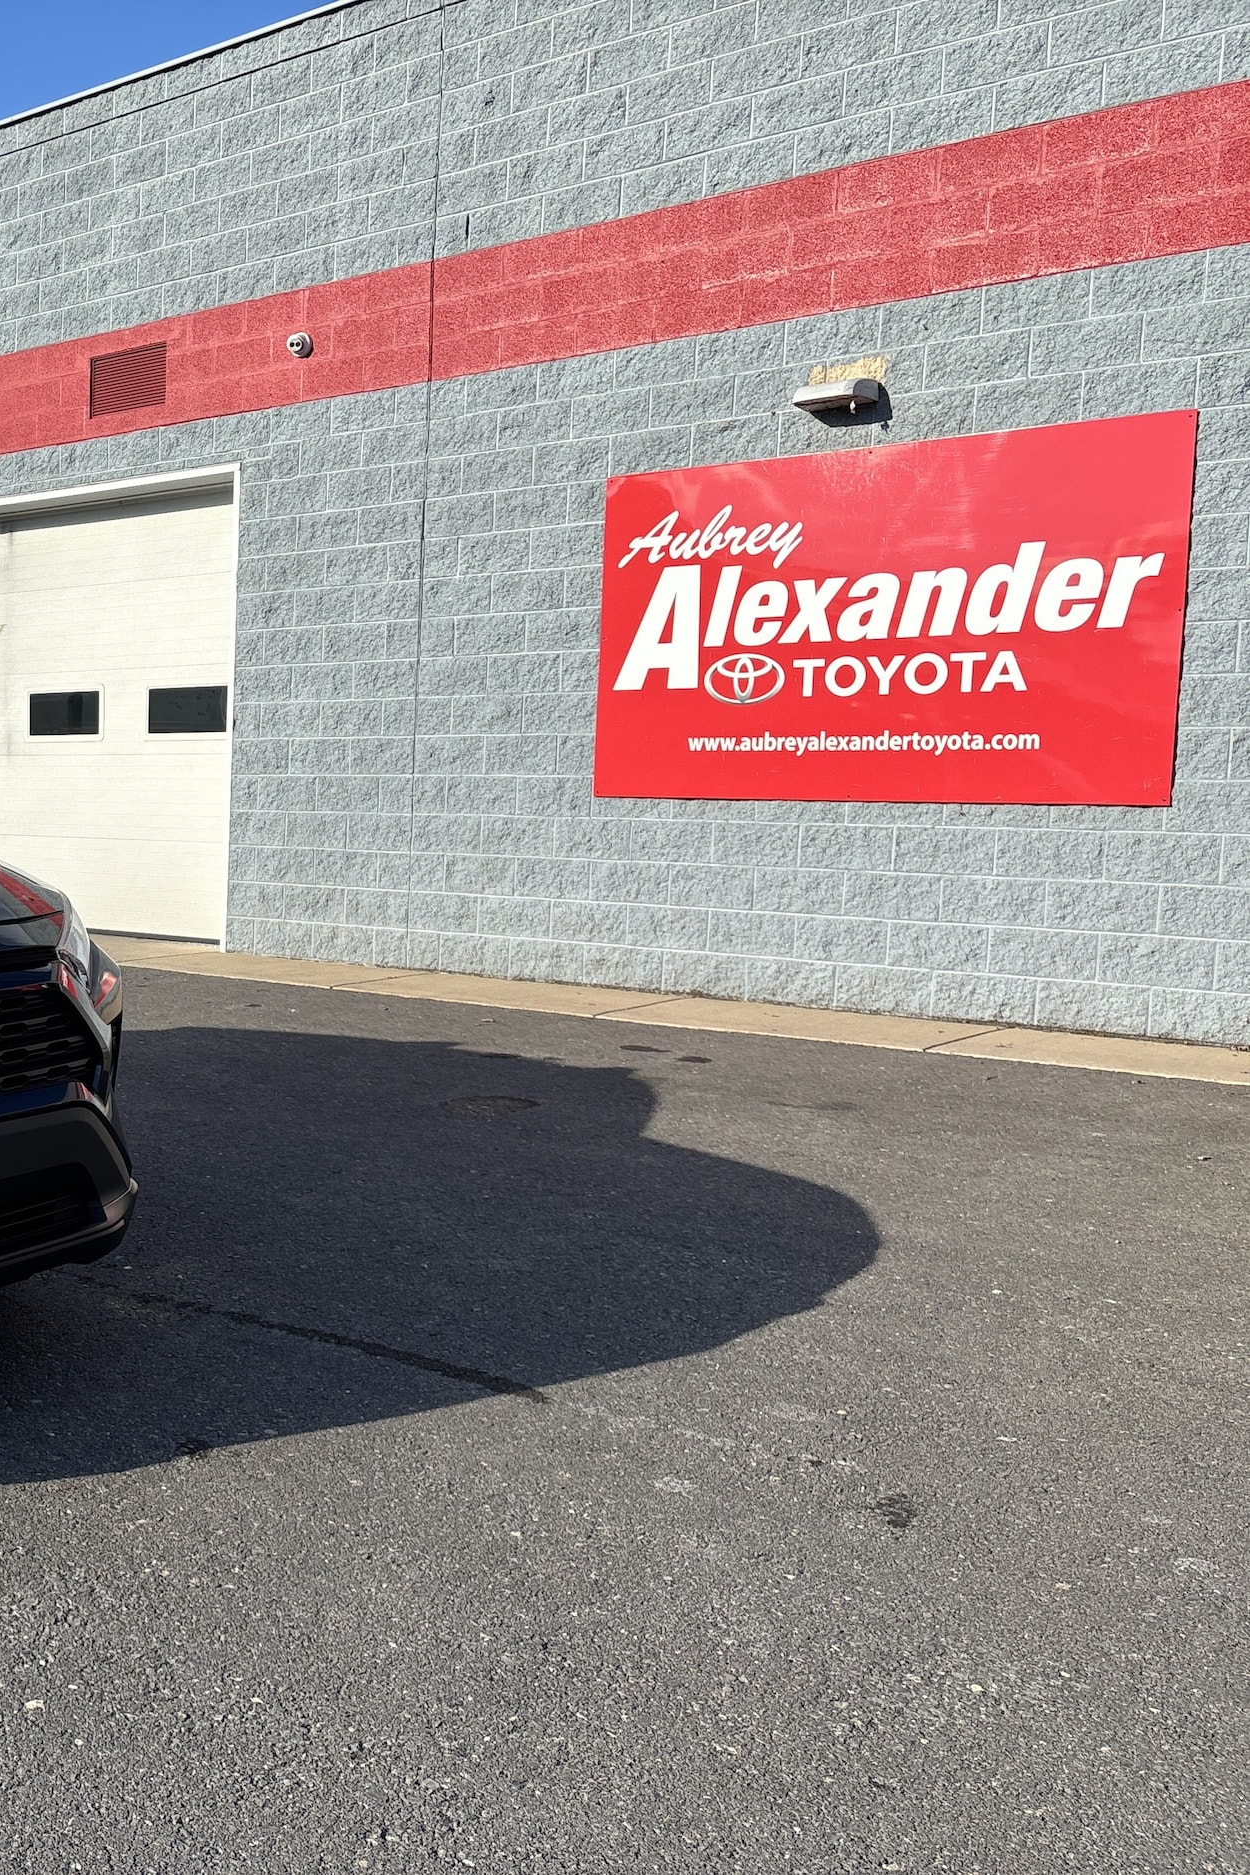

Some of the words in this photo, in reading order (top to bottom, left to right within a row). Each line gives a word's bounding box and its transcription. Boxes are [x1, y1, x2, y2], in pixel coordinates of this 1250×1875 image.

[618, 504, 803, 569] Aubrey
[612, 541, 1165, 691] Alexander
[792, 650, 1028, 697] TOYOTA
[688, 729, 1040, 756] www.aubreyalexandertoyota.com
